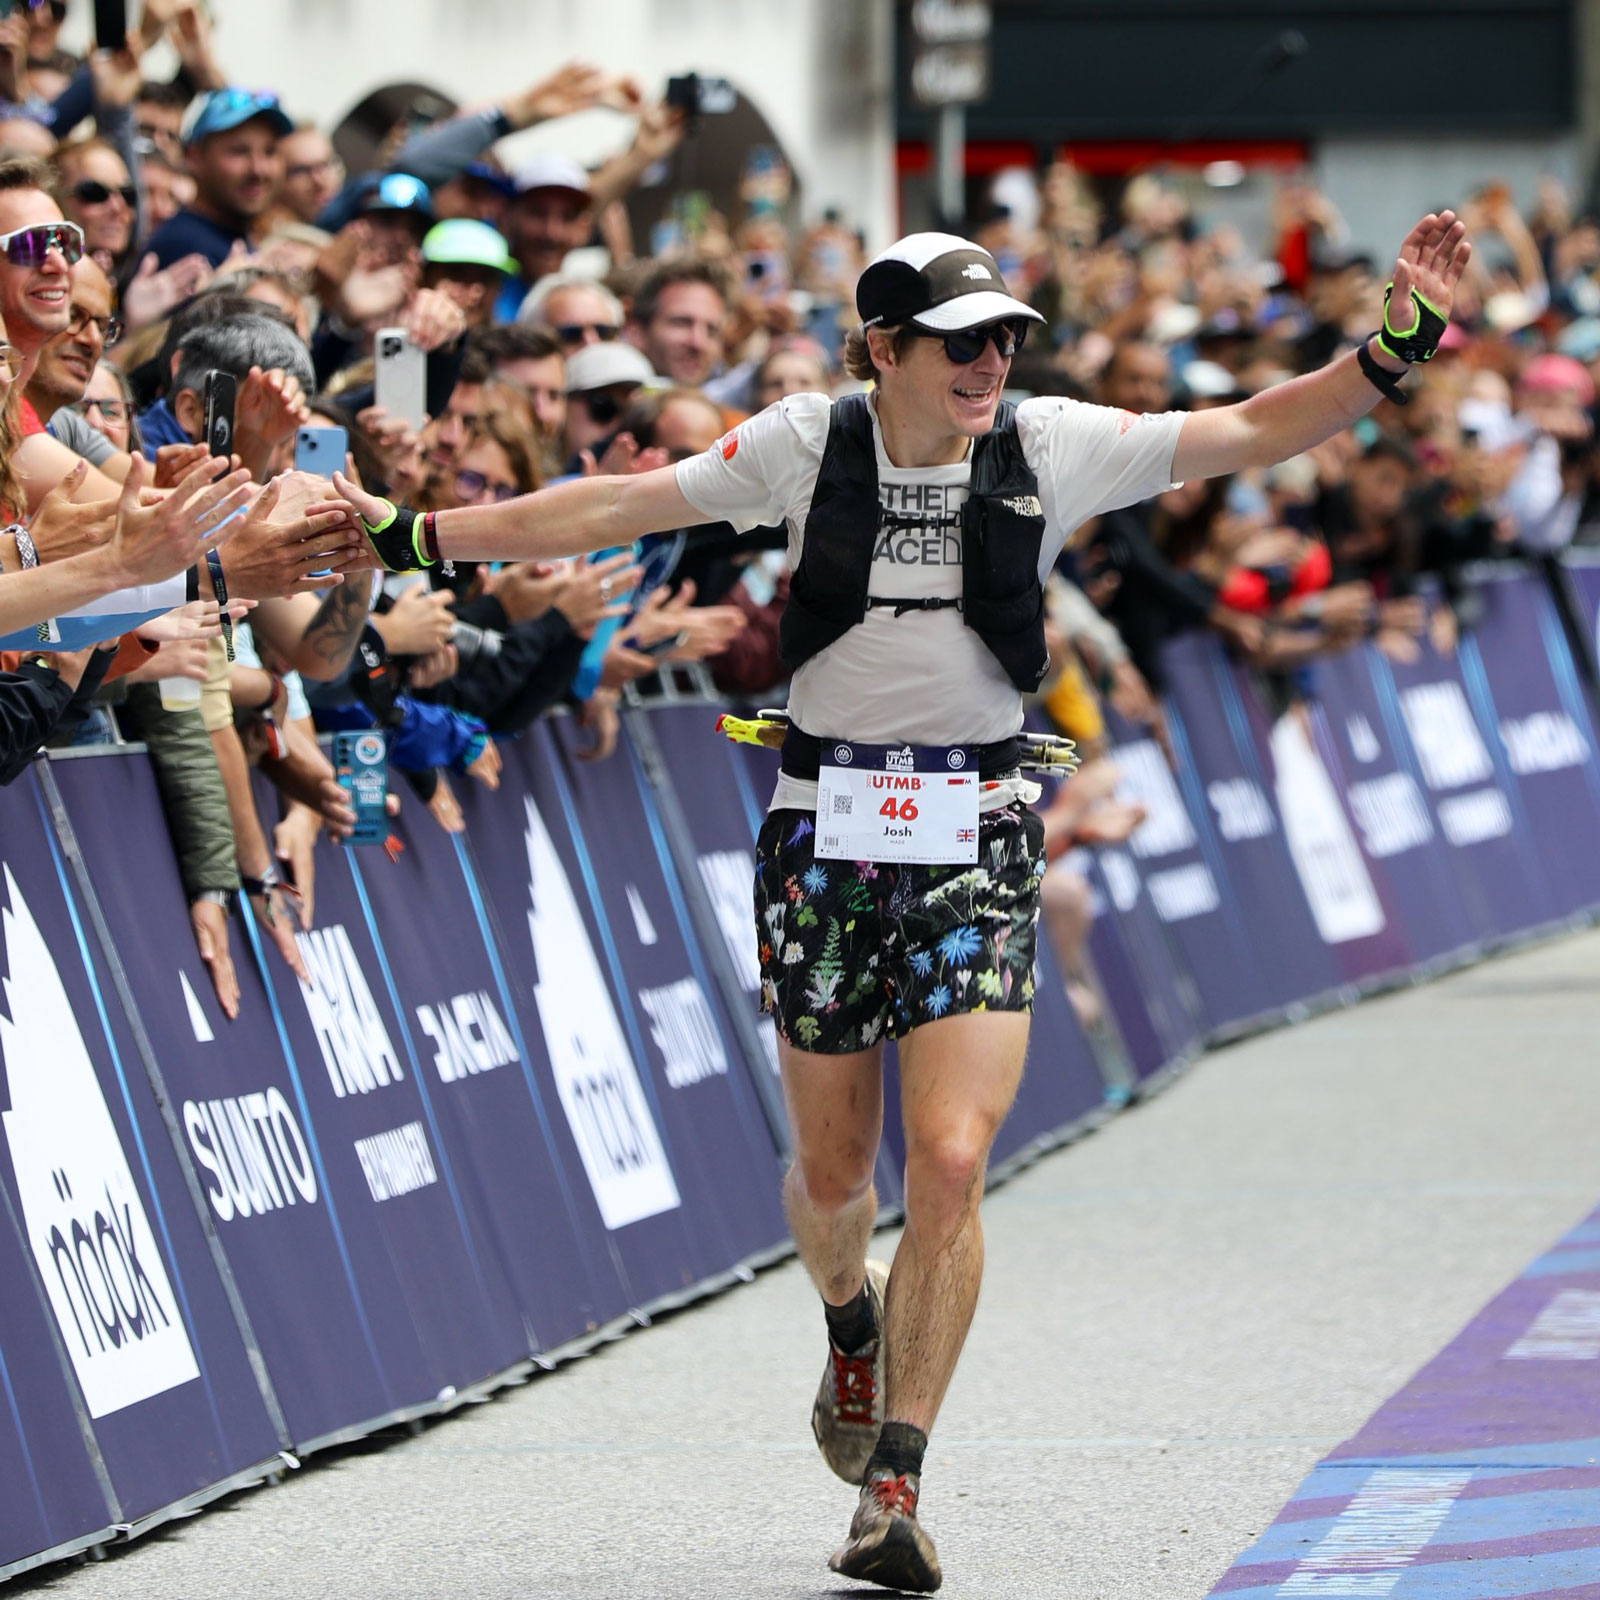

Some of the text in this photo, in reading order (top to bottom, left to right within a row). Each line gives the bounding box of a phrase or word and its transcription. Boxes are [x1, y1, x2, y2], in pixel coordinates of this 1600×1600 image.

[881, 483, 943, 511] THE
[872, 536, 942, 566] ACE
[886, 755, 914, 766] UTMB
[873, 775, 921, 791] UTMB
[879, 797, 919, 821] 46
[883, 826, 912, 837] Josh
[183, 1086, 318, 1222] SUUNTO
